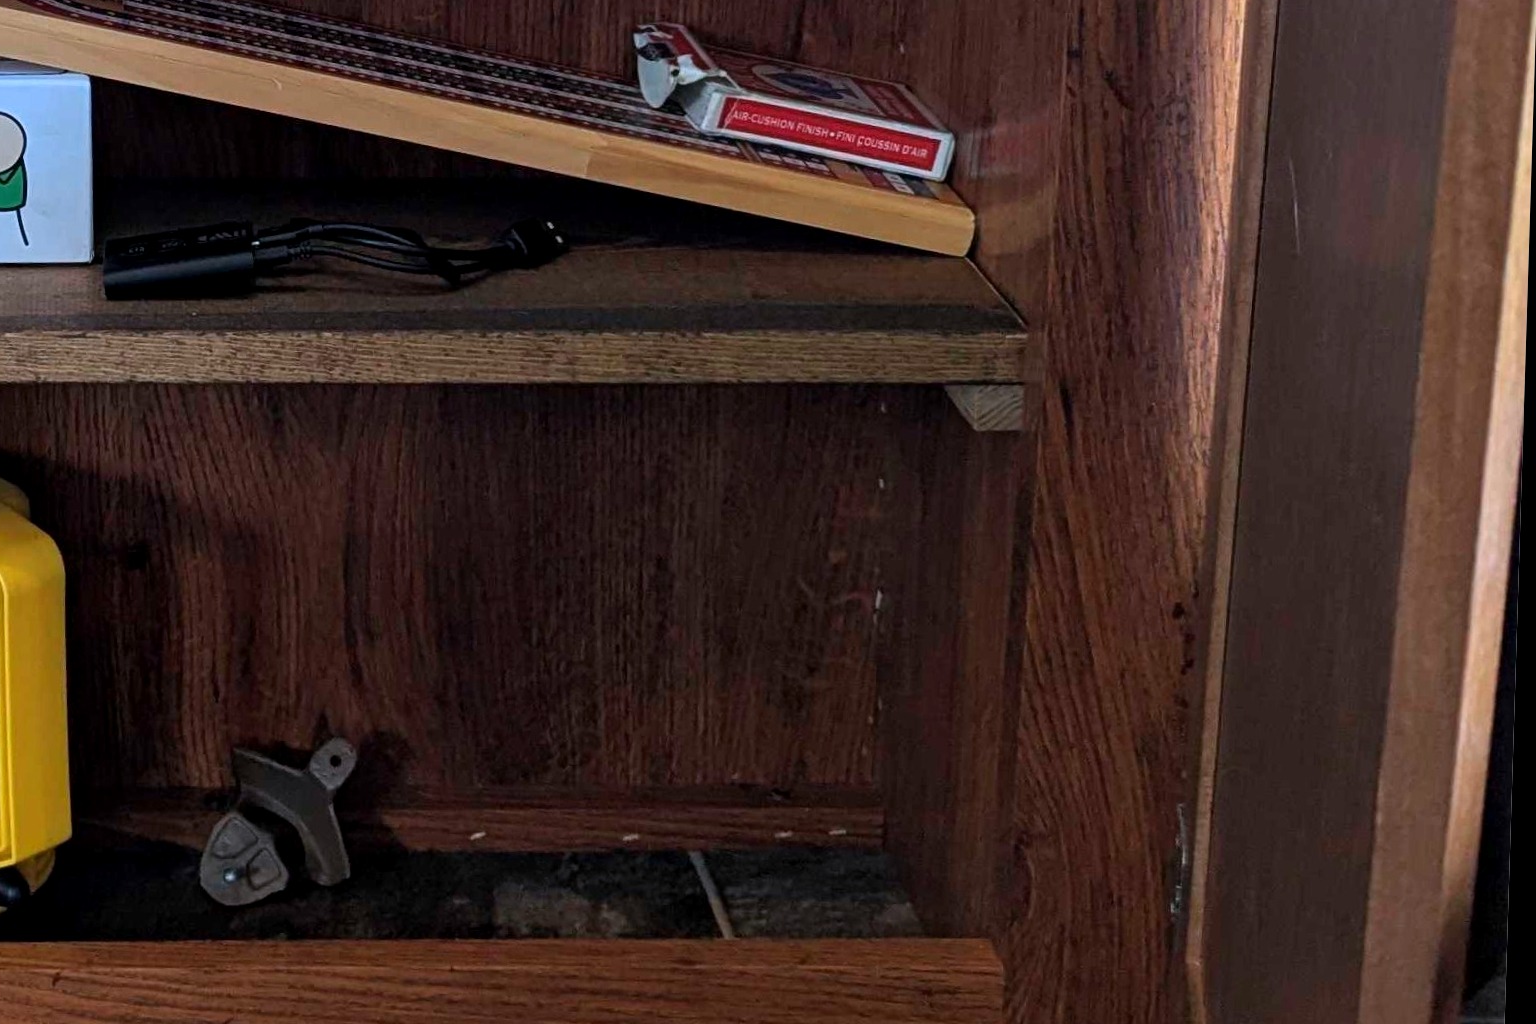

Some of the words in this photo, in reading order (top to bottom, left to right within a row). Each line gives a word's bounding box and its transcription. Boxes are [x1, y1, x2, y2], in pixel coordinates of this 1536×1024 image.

[732, 111, 795, 131] AIR-CUSHION
[796, 122, 829, 138] FINISH
[836, 131, 855, 144] FINI
[902, 145, 928, 158] D'AIR
